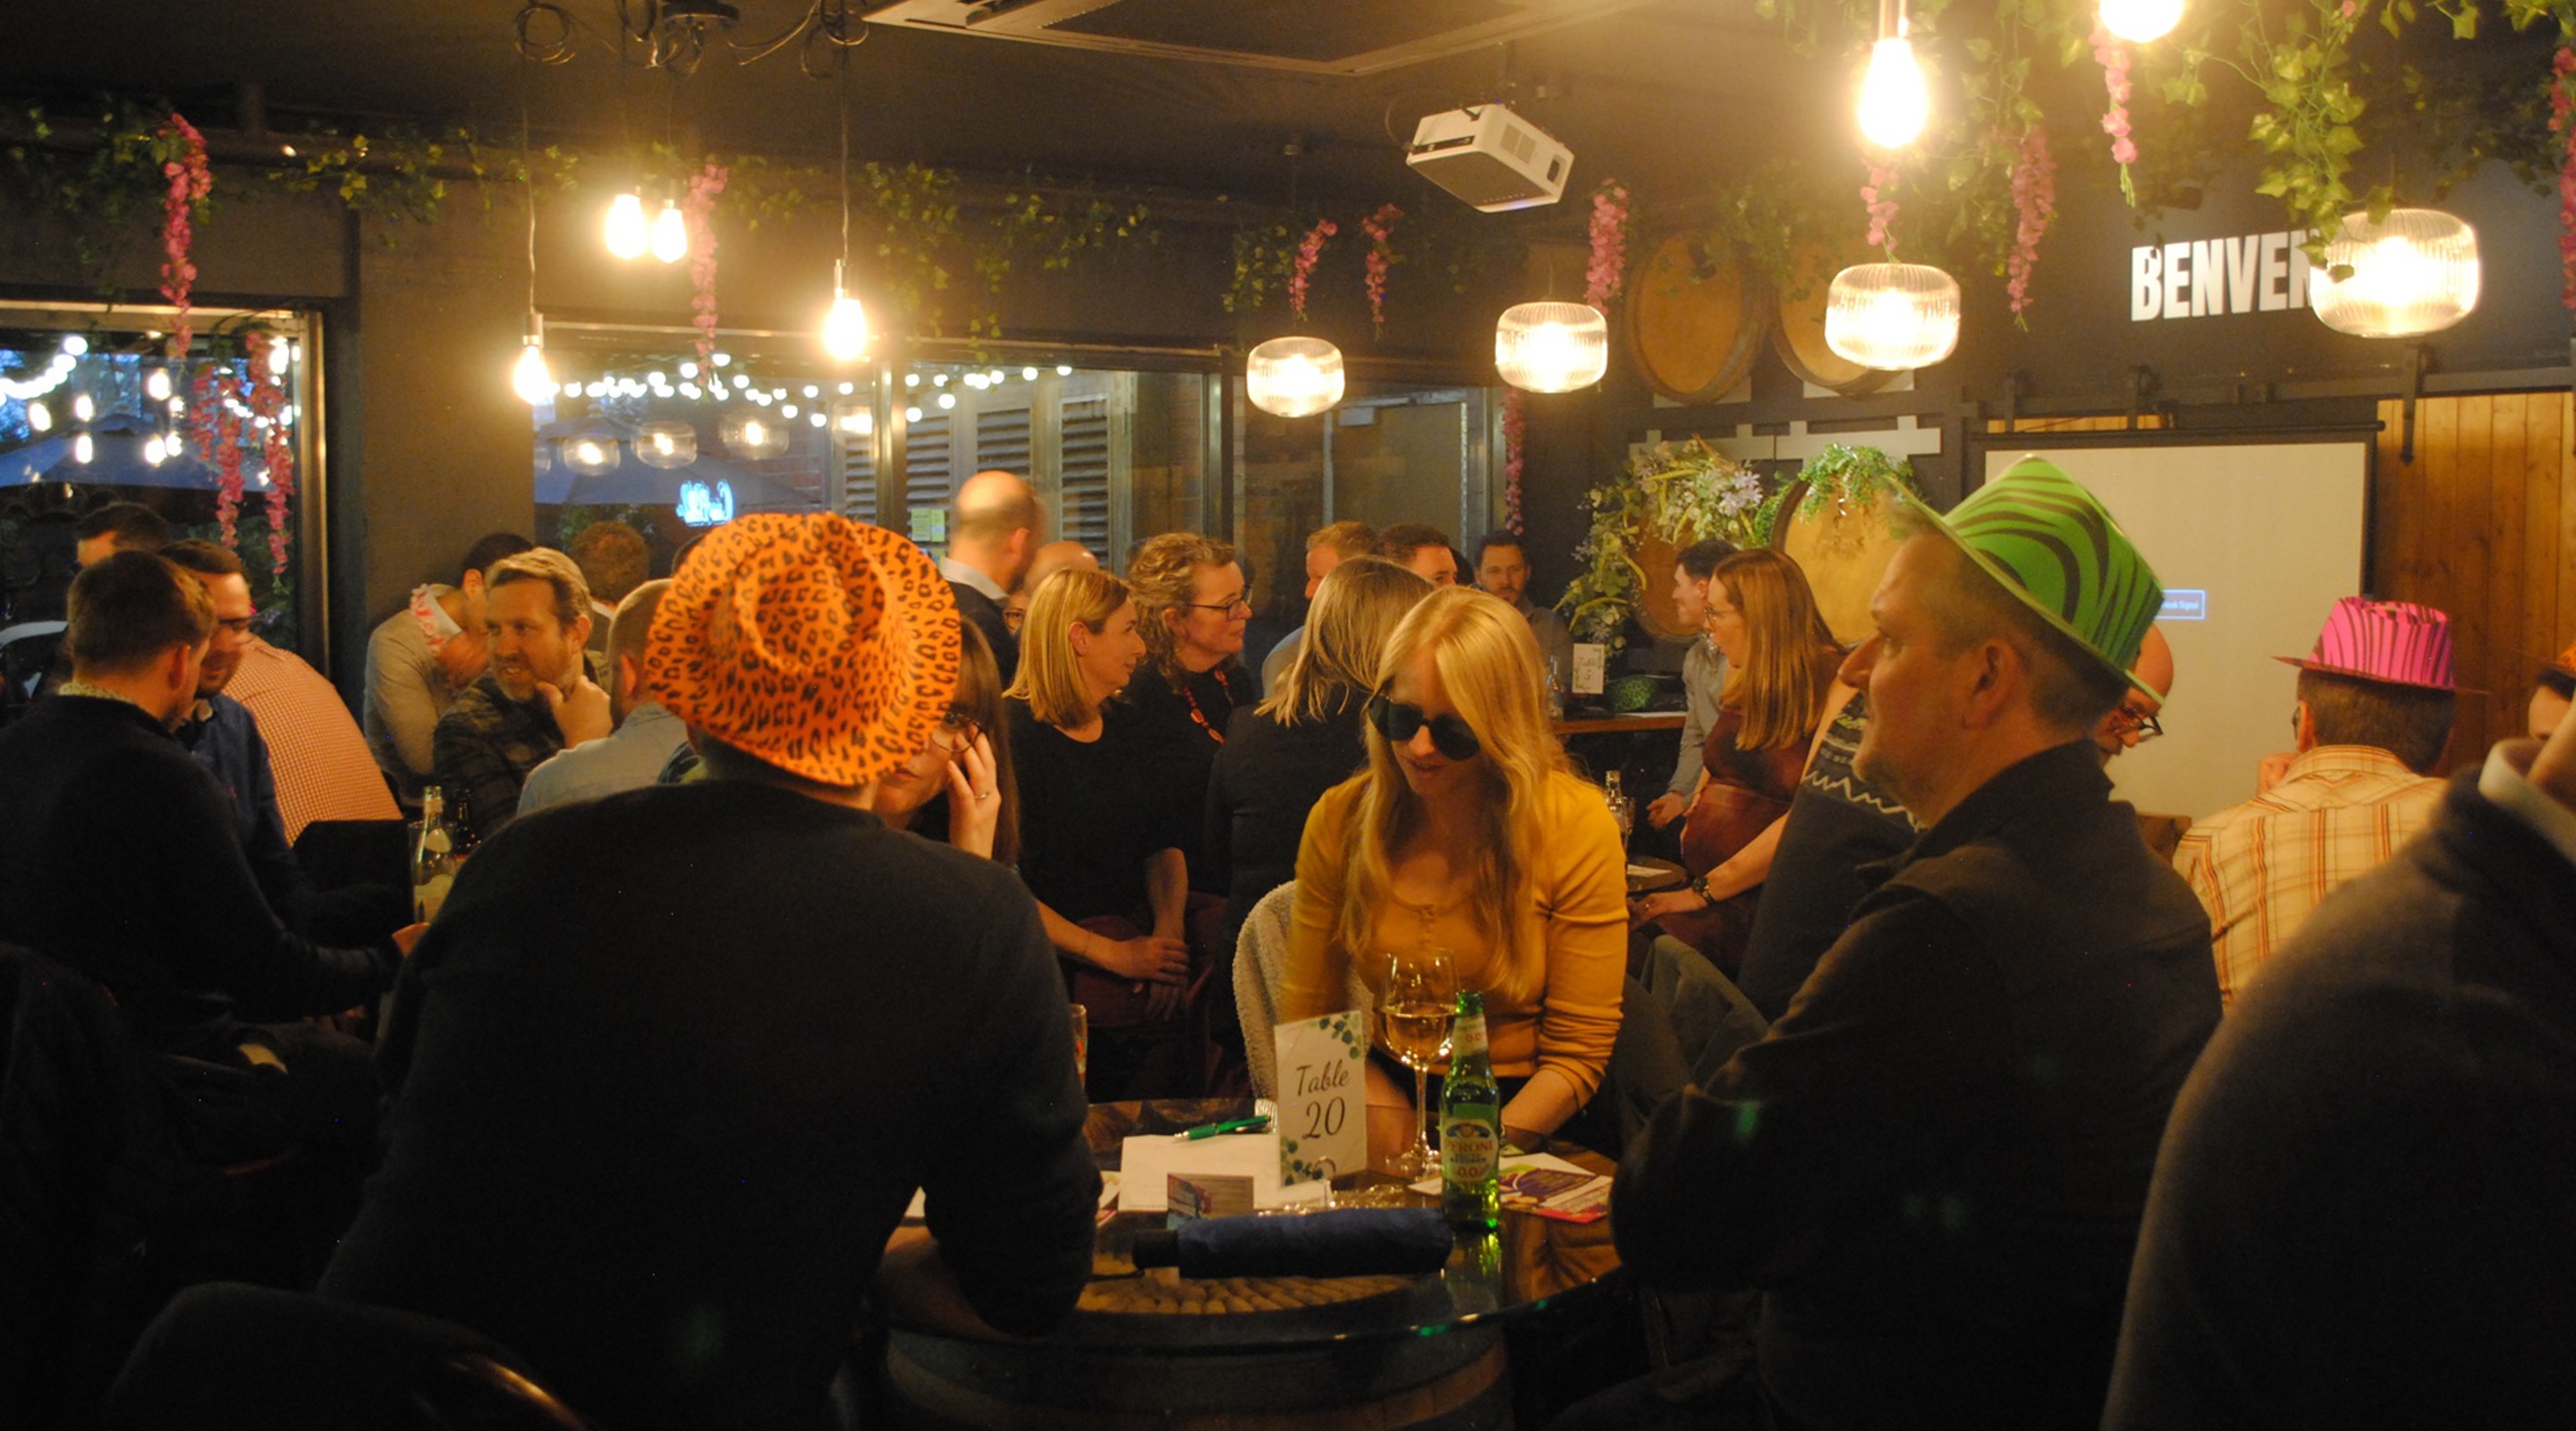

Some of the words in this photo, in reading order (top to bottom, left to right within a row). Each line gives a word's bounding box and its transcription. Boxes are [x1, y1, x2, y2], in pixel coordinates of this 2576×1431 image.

[1296, 1059, 1349, 1097] Table
[1302, 1097, 1345, 1139] 20
[1445, 1138, 1493, 1153] PERONI
